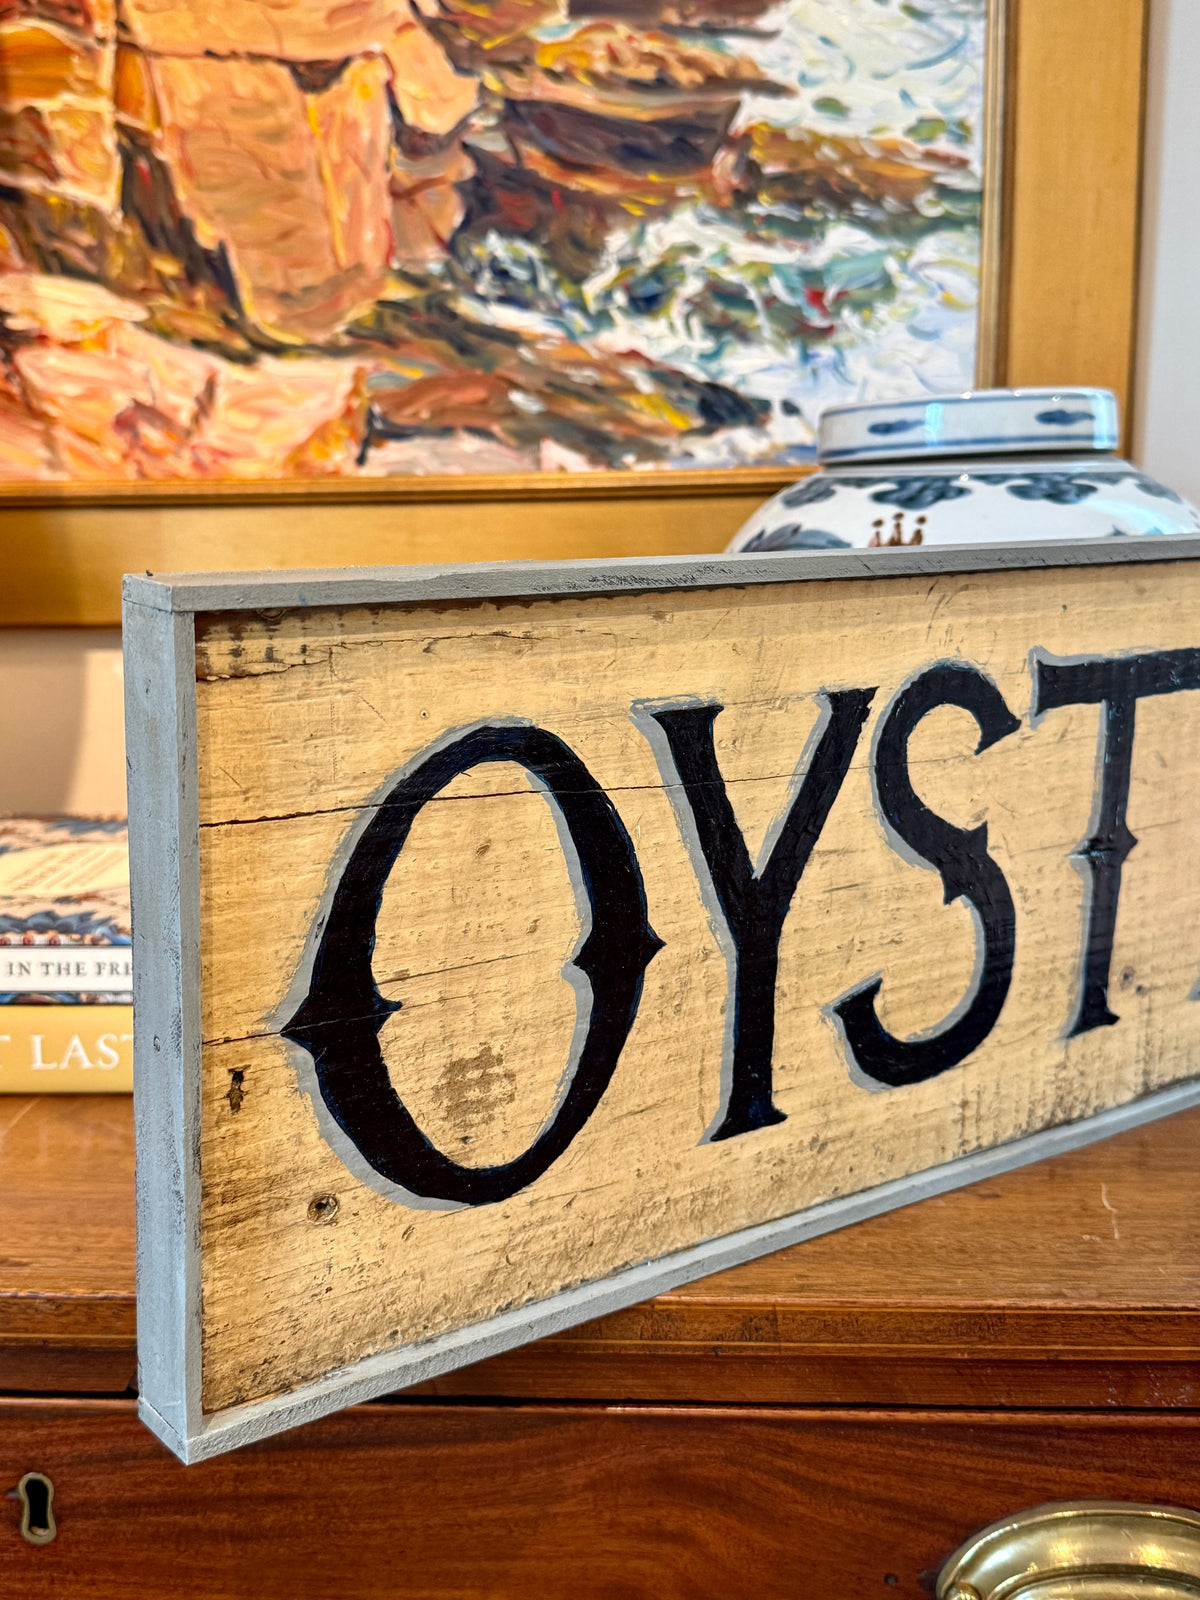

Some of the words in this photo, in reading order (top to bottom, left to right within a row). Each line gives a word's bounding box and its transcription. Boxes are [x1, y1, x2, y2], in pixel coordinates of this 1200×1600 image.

[8, 961, 32, 976] IN
[40, 961, 87, 976] THE
[274, 646, 1200, 1209] OYST
